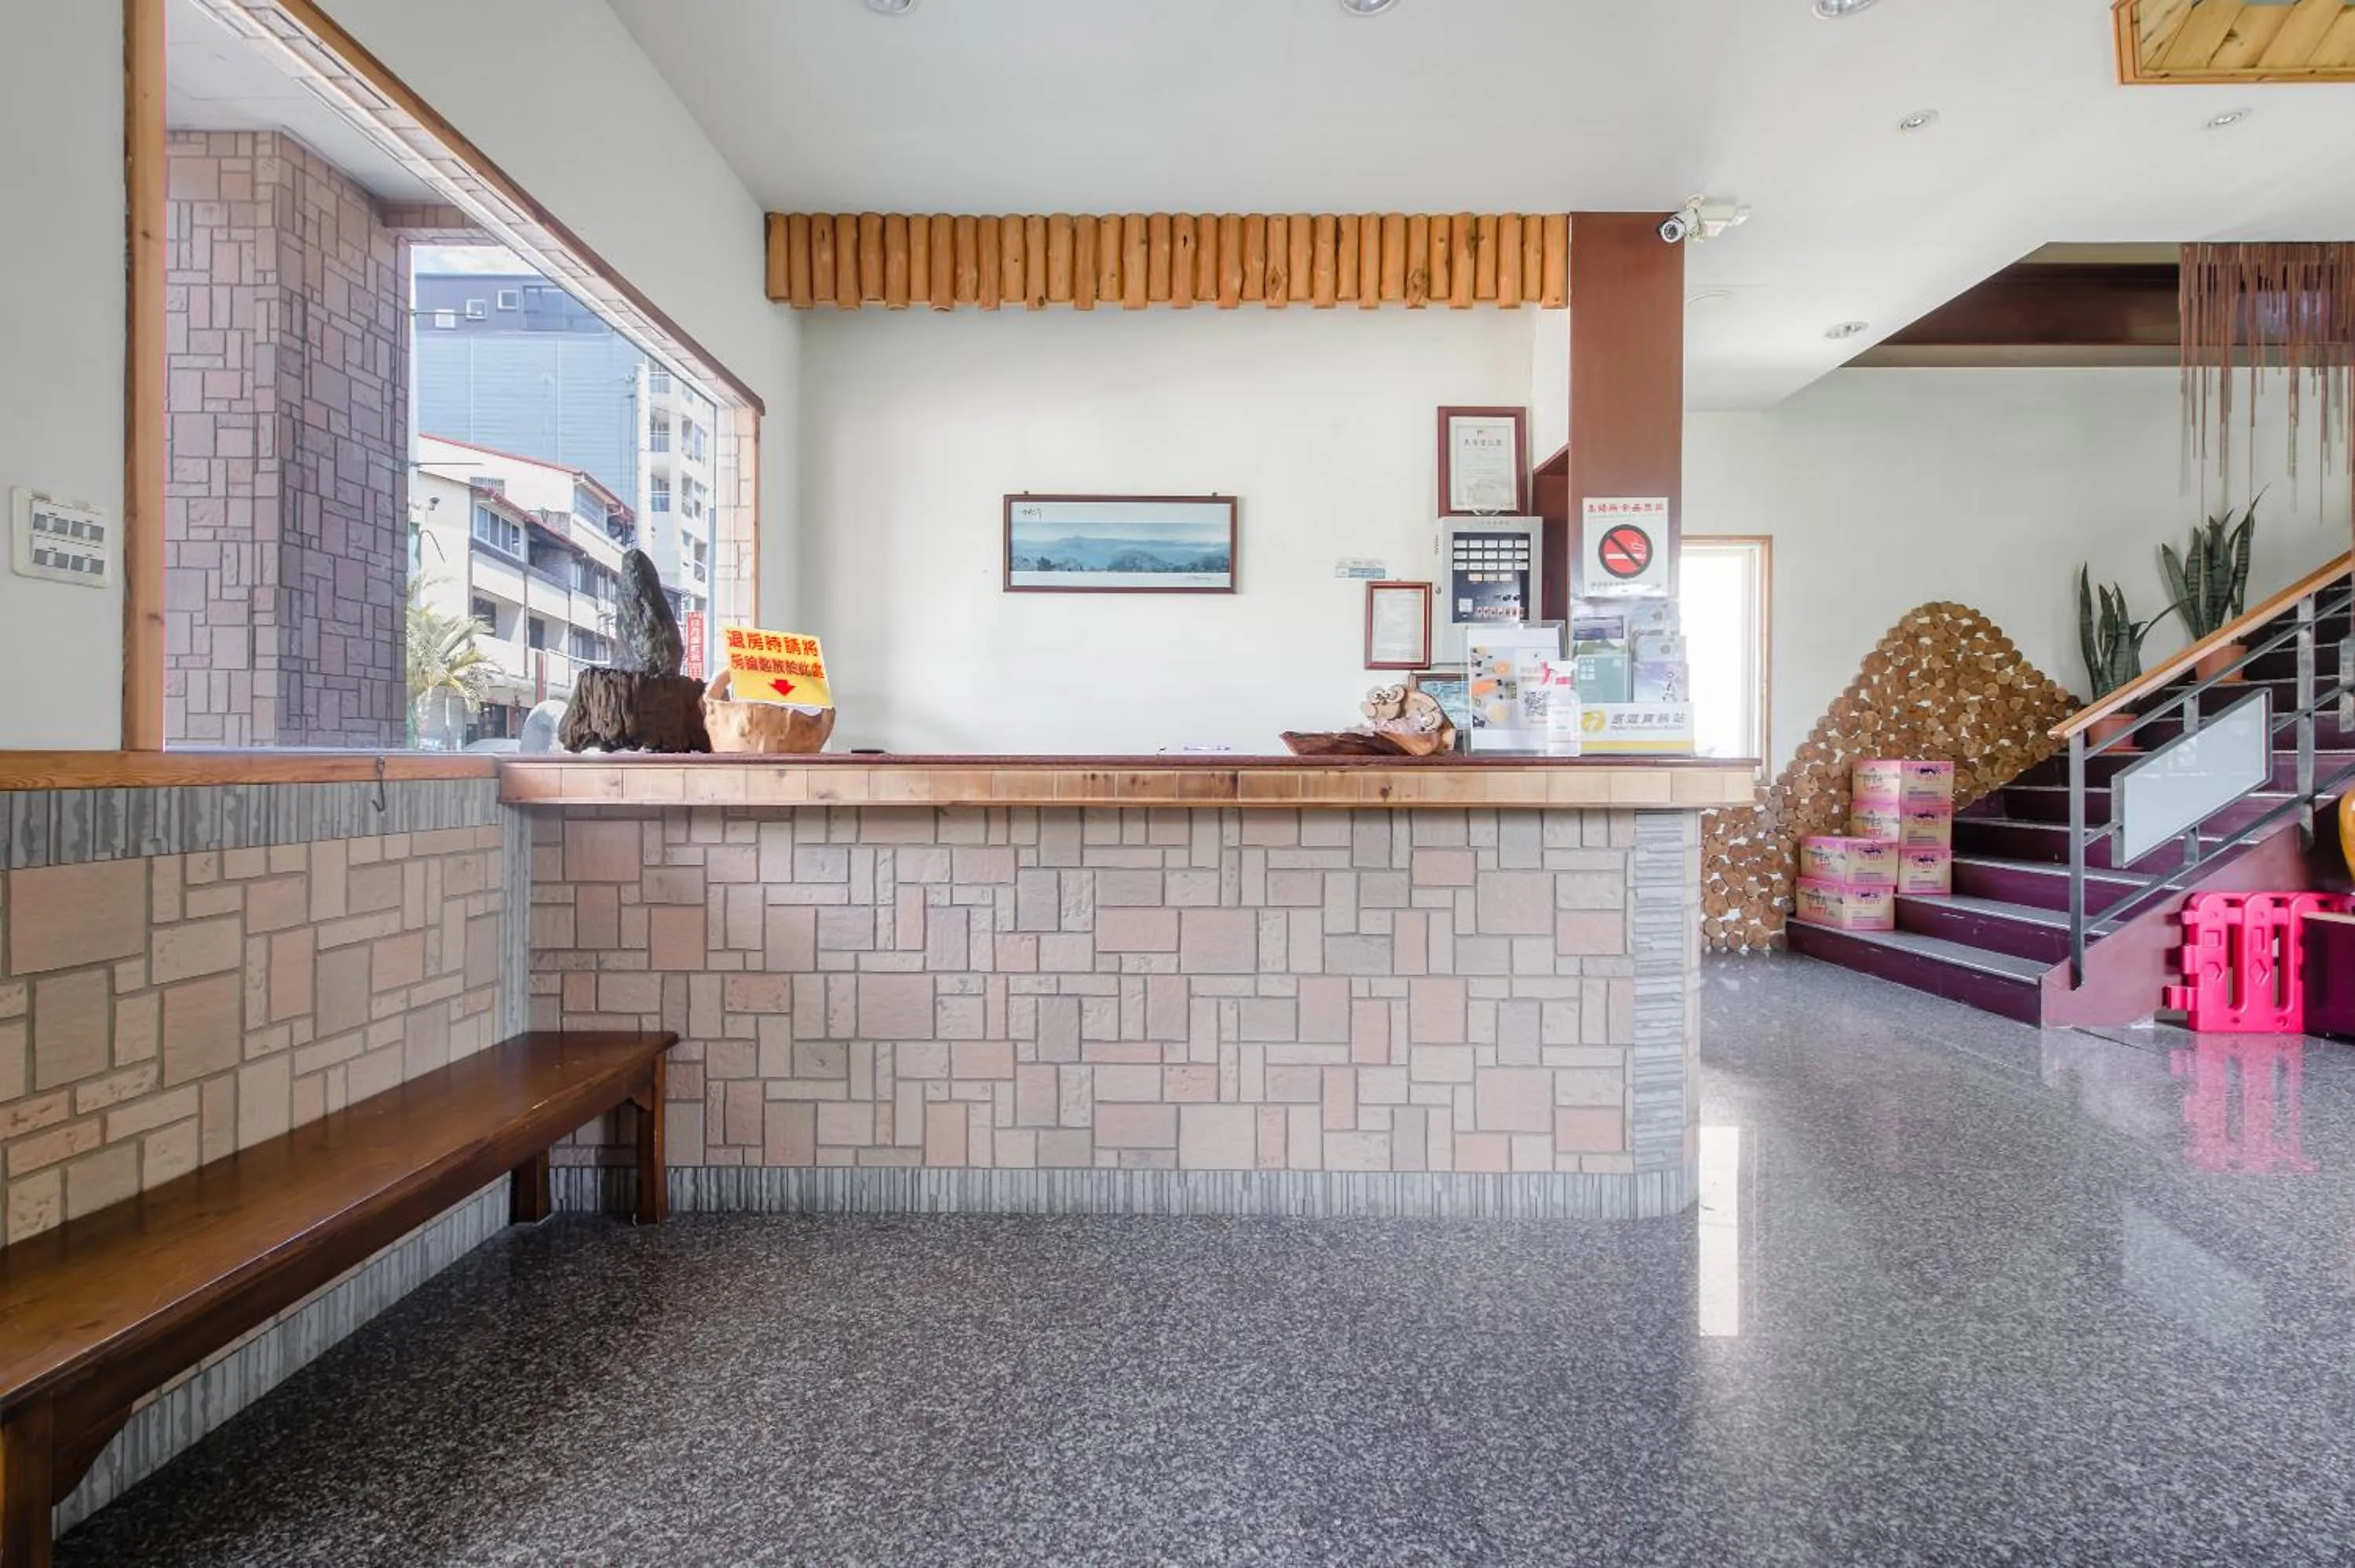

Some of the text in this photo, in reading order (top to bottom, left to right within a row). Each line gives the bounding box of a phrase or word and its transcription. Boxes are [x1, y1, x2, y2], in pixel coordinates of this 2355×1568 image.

[727, 629, 818, 656] 退房時請將
